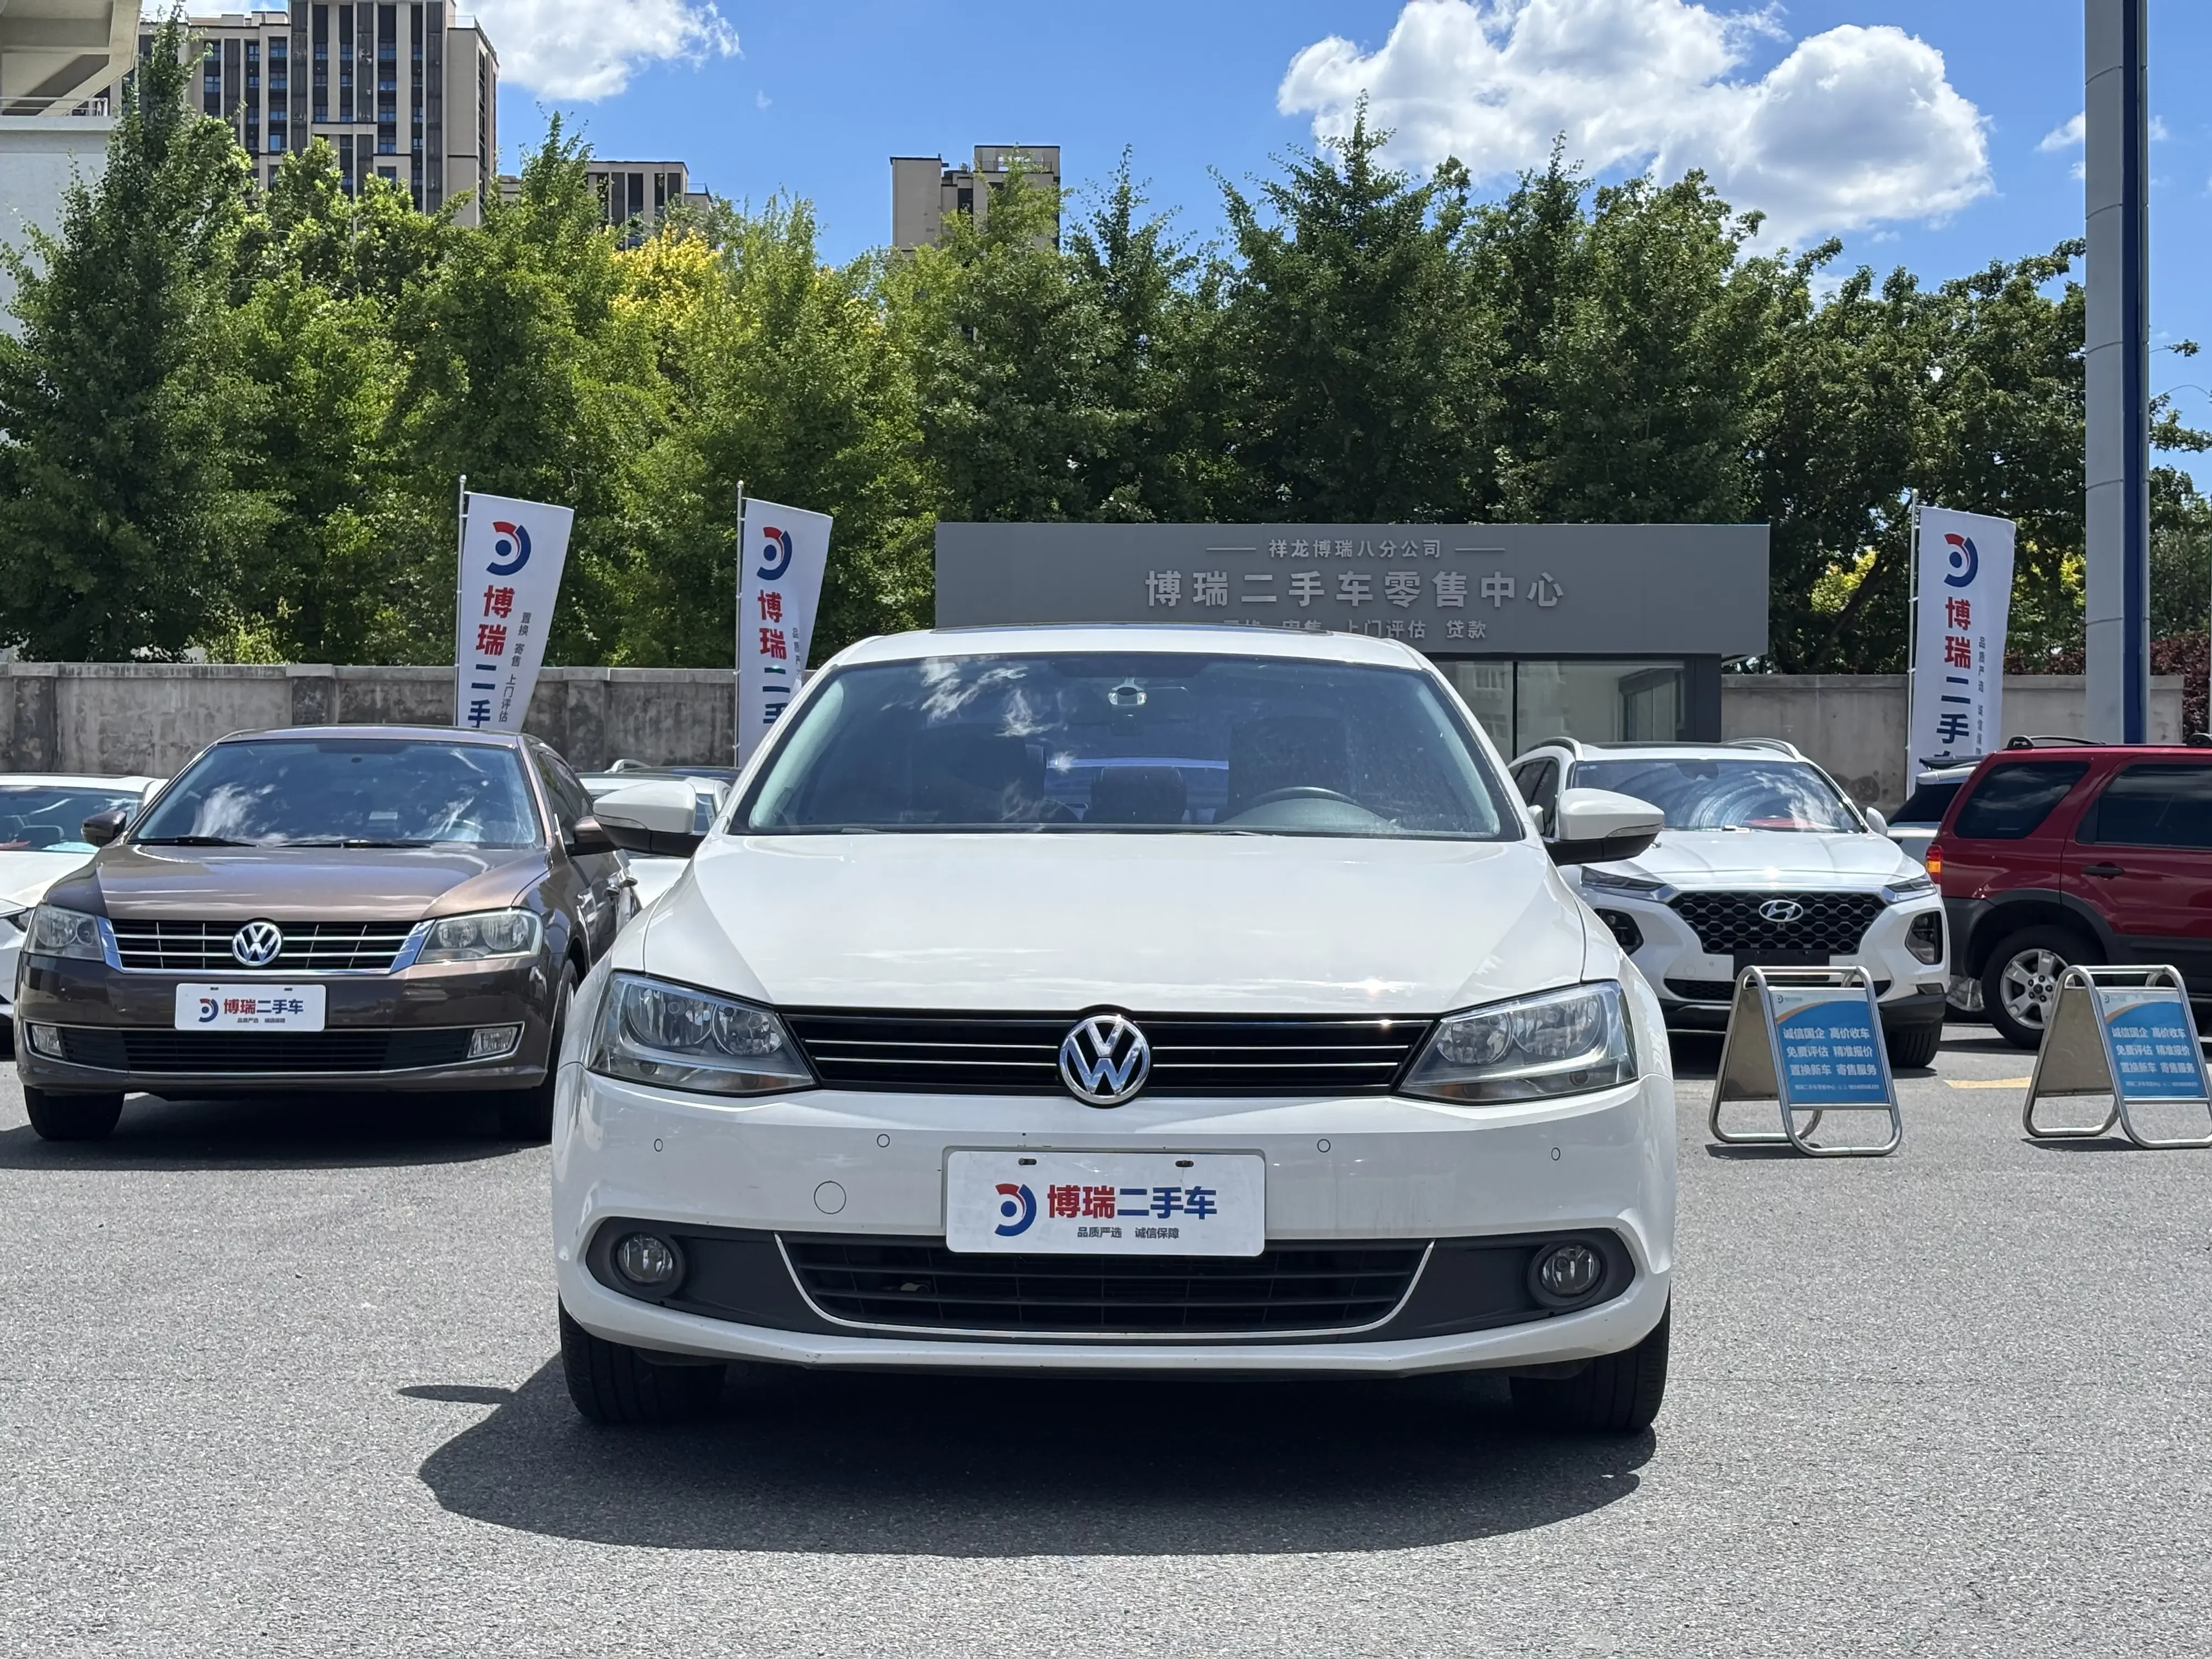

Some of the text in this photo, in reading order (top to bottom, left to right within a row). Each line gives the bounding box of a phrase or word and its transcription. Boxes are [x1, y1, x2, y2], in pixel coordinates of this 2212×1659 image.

[1268, 539, 1441, 558] 祥龙博瑞八分公司
[1145, 570, 1564, 608] 博瑞二手车零售中心
[1446, 620, 1487, 639] 贷款
[468, 584, 515, 728] 博瑞二手
[498, 612, 532, 723] 置换 寄售 上门评估
[1934, 596, 1971, 757] 博瑞二手
[224, 998, 304, 1014] 博瑞二手车
[1783, 1028, 1870, 1039] 诚信国企 高价收车
[2112, 1027, 2186, 1039] 诚信国企 高价收车
[1786, 1046, 1873, 1058] 免费评估 精准报价
[2116, 1045, 2190, 1056] 免费评估 精准报价
[1790, 1064, 1877, 1076] 置换新车 寄售服务
[2120, 1062, 2157, 1073] 置换新车
[1047, 1184, 1217, 1220] 博瑞二手车
[1077, 1227, 1180, 1239] 品质严选 诚信保障
